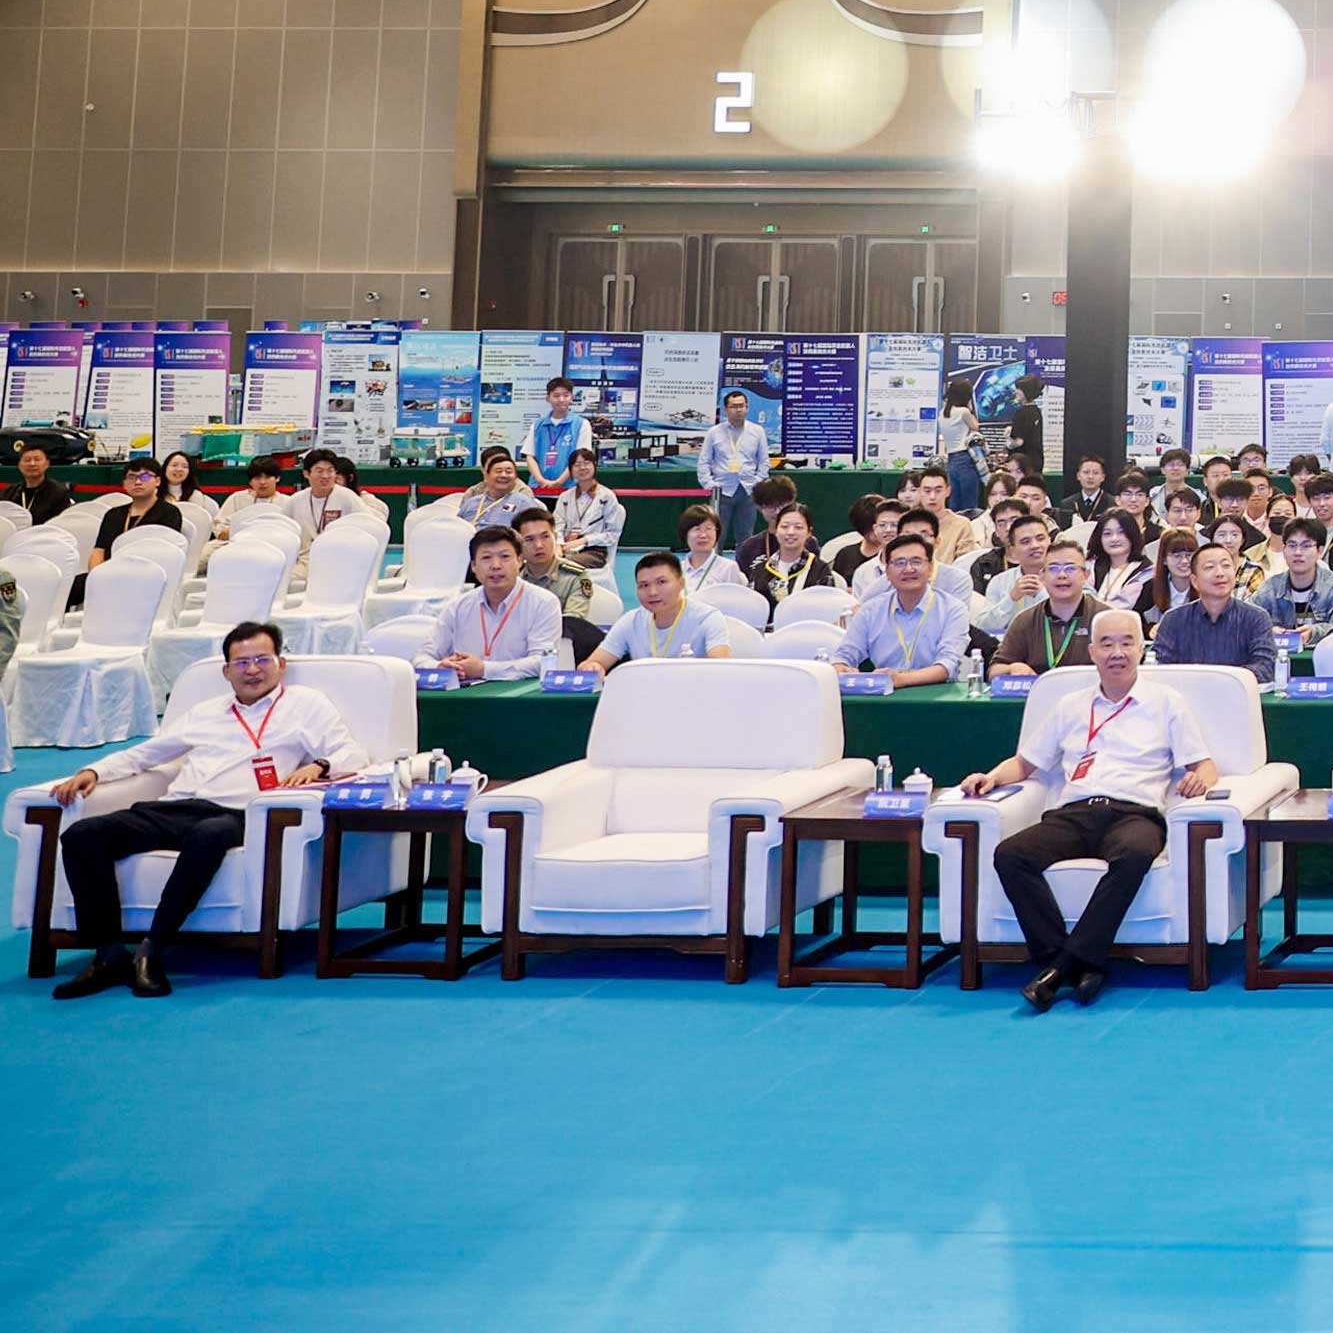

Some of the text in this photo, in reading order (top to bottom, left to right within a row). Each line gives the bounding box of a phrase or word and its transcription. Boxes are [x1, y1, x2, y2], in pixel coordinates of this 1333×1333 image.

[714, 71, 754, 133] 2
[958, 345, 1018, 361] 智洁卫士
